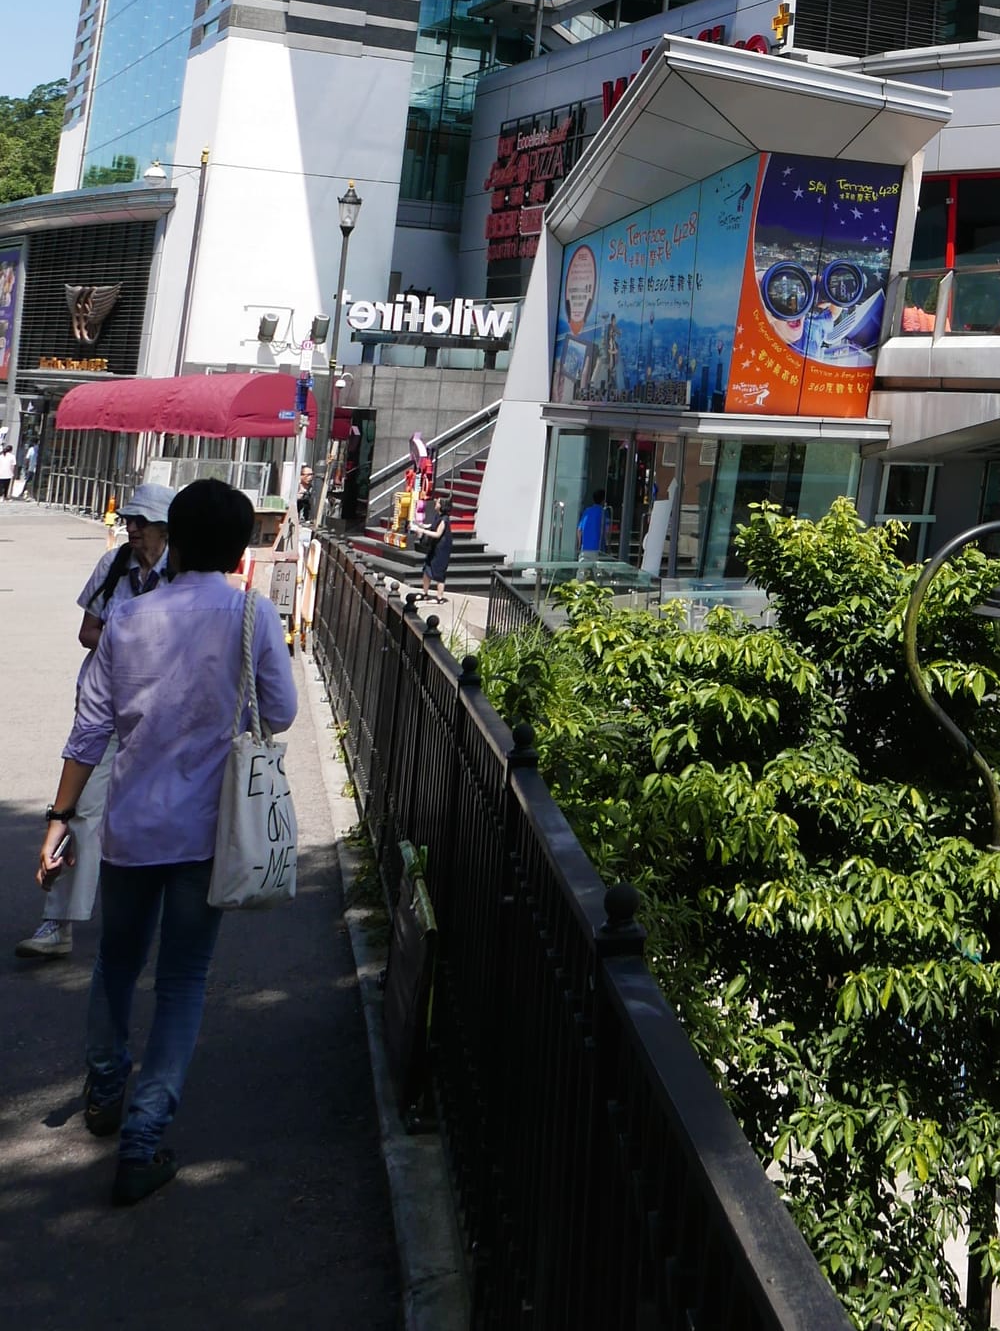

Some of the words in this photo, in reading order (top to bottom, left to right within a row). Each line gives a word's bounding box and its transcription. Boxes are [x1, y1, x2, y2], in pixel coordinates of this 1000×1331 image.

[529, 144, 564, 182] PIZZA
[836, 178, 873, 193] Terrace
[879, 183, 900, 196] 428
[626, 223, 667, 246] Terrace
[673, 211, 698, 246] 428
[276, 570, 291, 582] End
